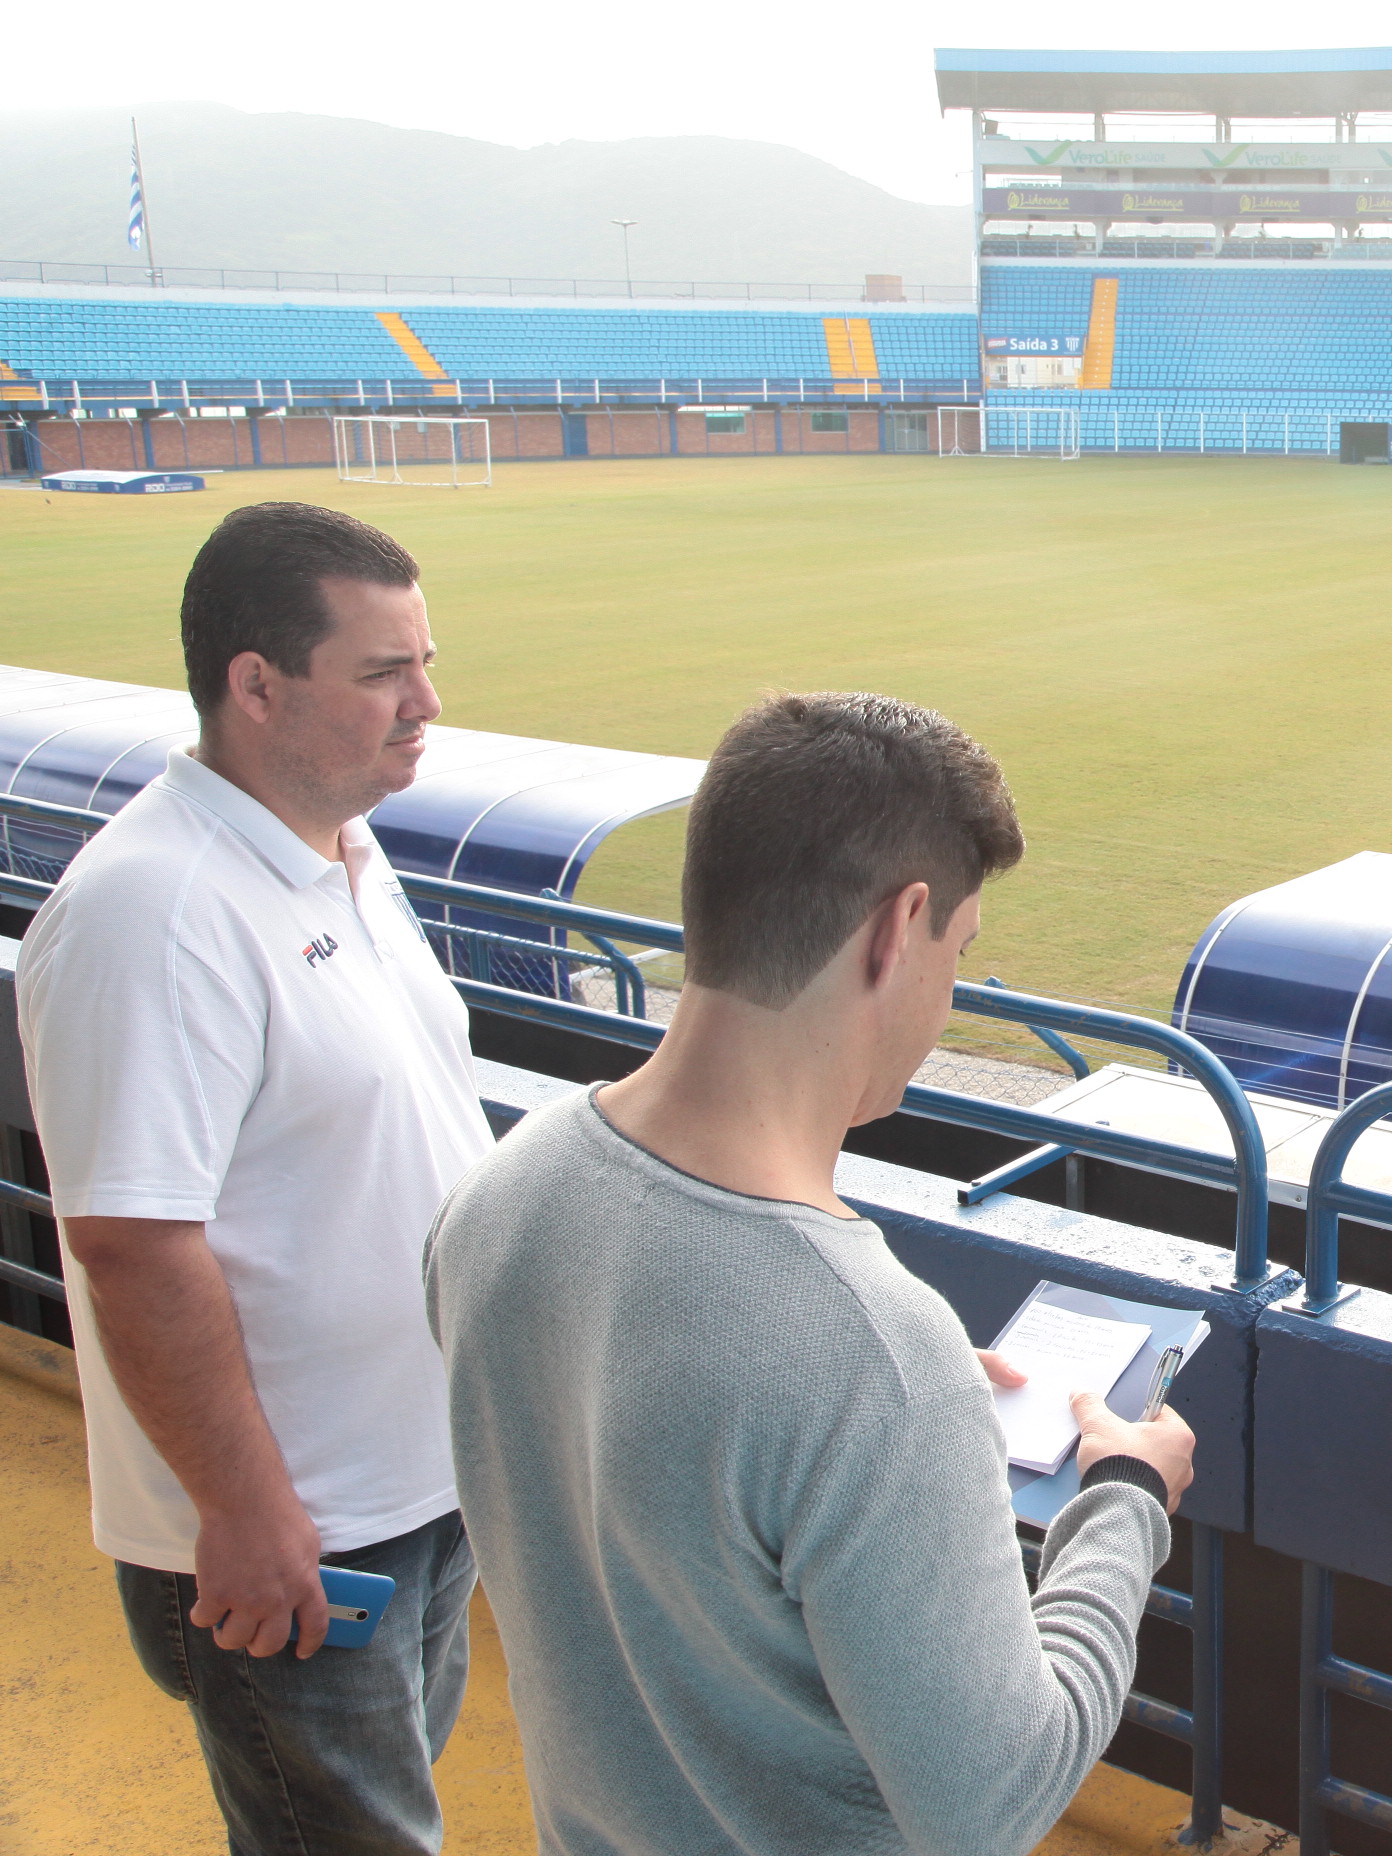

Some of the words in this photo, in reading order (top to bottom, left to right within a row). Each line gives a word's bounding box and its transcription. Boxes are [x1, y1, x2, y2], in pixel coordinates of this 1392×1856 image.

[1010, 337, 1048, 351] Saída
[1050, 338, 1059, 351] 3
[302, 932, 338, 968] FILA
